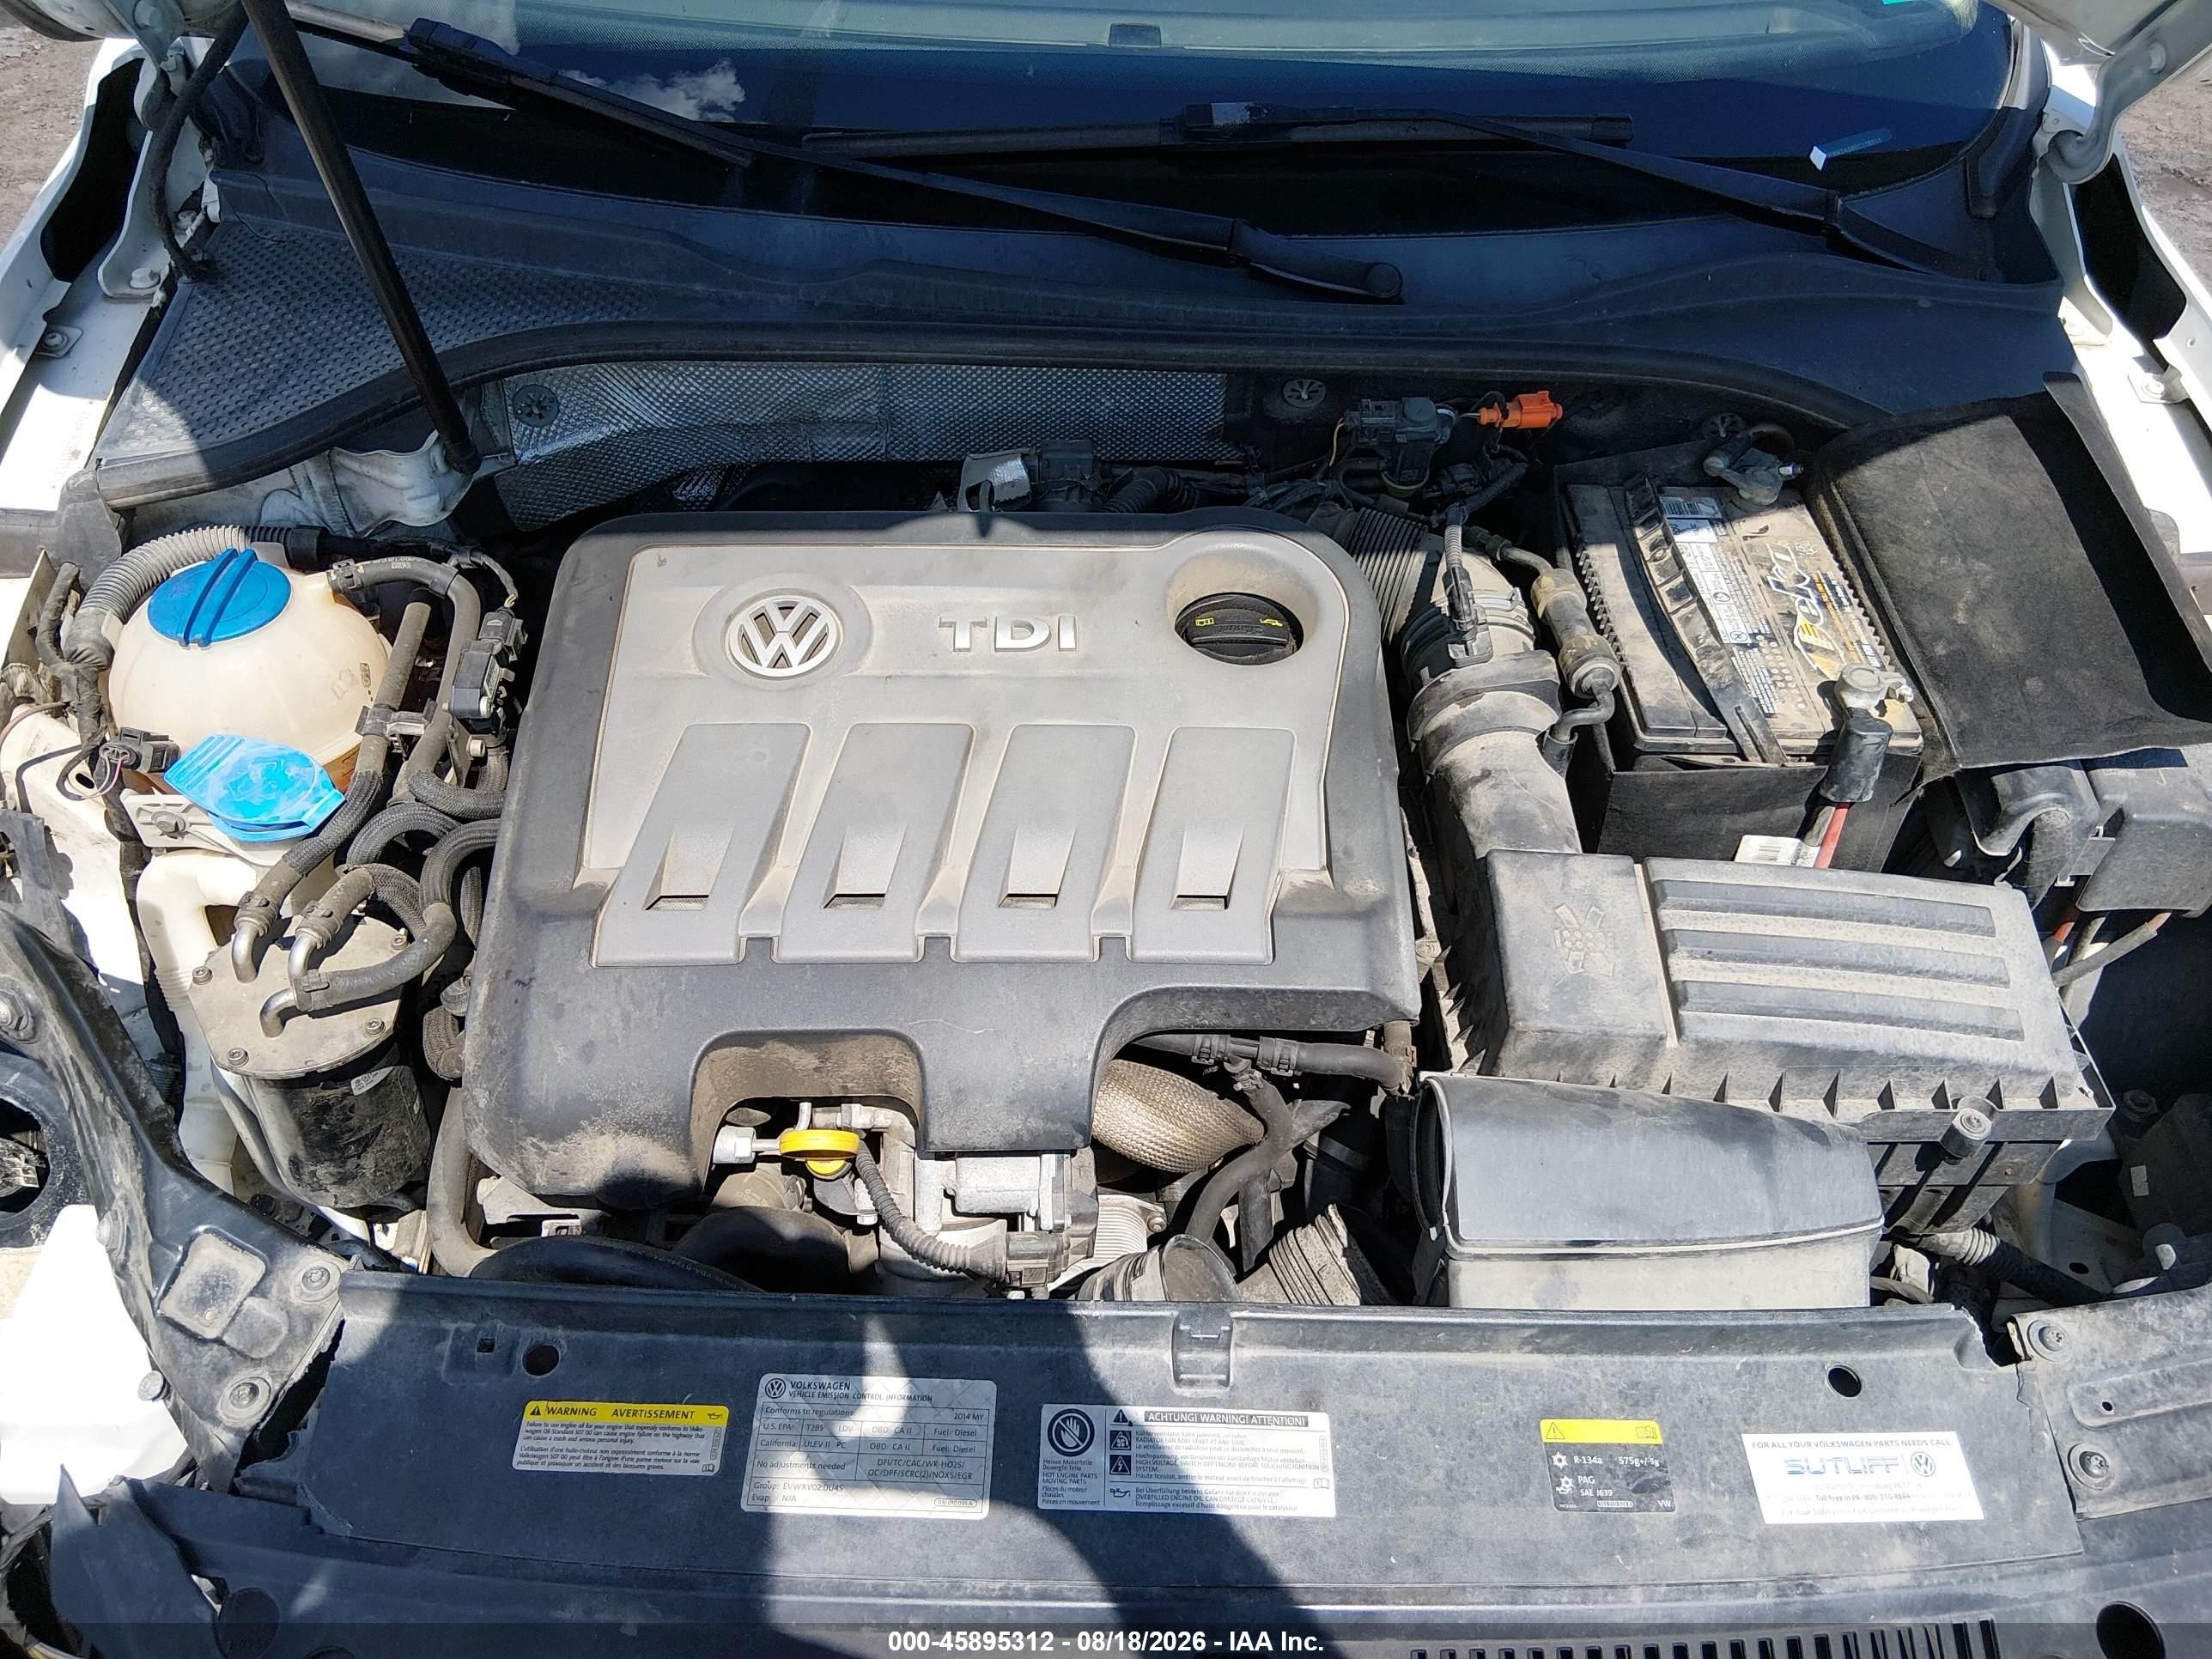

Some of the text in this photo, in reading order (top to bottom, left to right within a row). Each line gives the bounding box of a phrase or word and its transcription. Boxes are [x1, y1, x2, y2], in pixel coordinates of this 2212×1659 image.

[939, 615, 1079, 653] TDI
[790, 1381, 851, 1390] VOLKSWAGEN
[547, 1407, 696, 1419] WARNING AVERTISSEMENT
[1148, 1413, 1305, 1426] ACHTUNG! WARNING! ATTENTION!
[1573, 1455, 1603, 1464] R-134a
[1784, 1456, 1899, 1475] SUTLIFF
[1577, 1475, 1595, 1484] PAG
